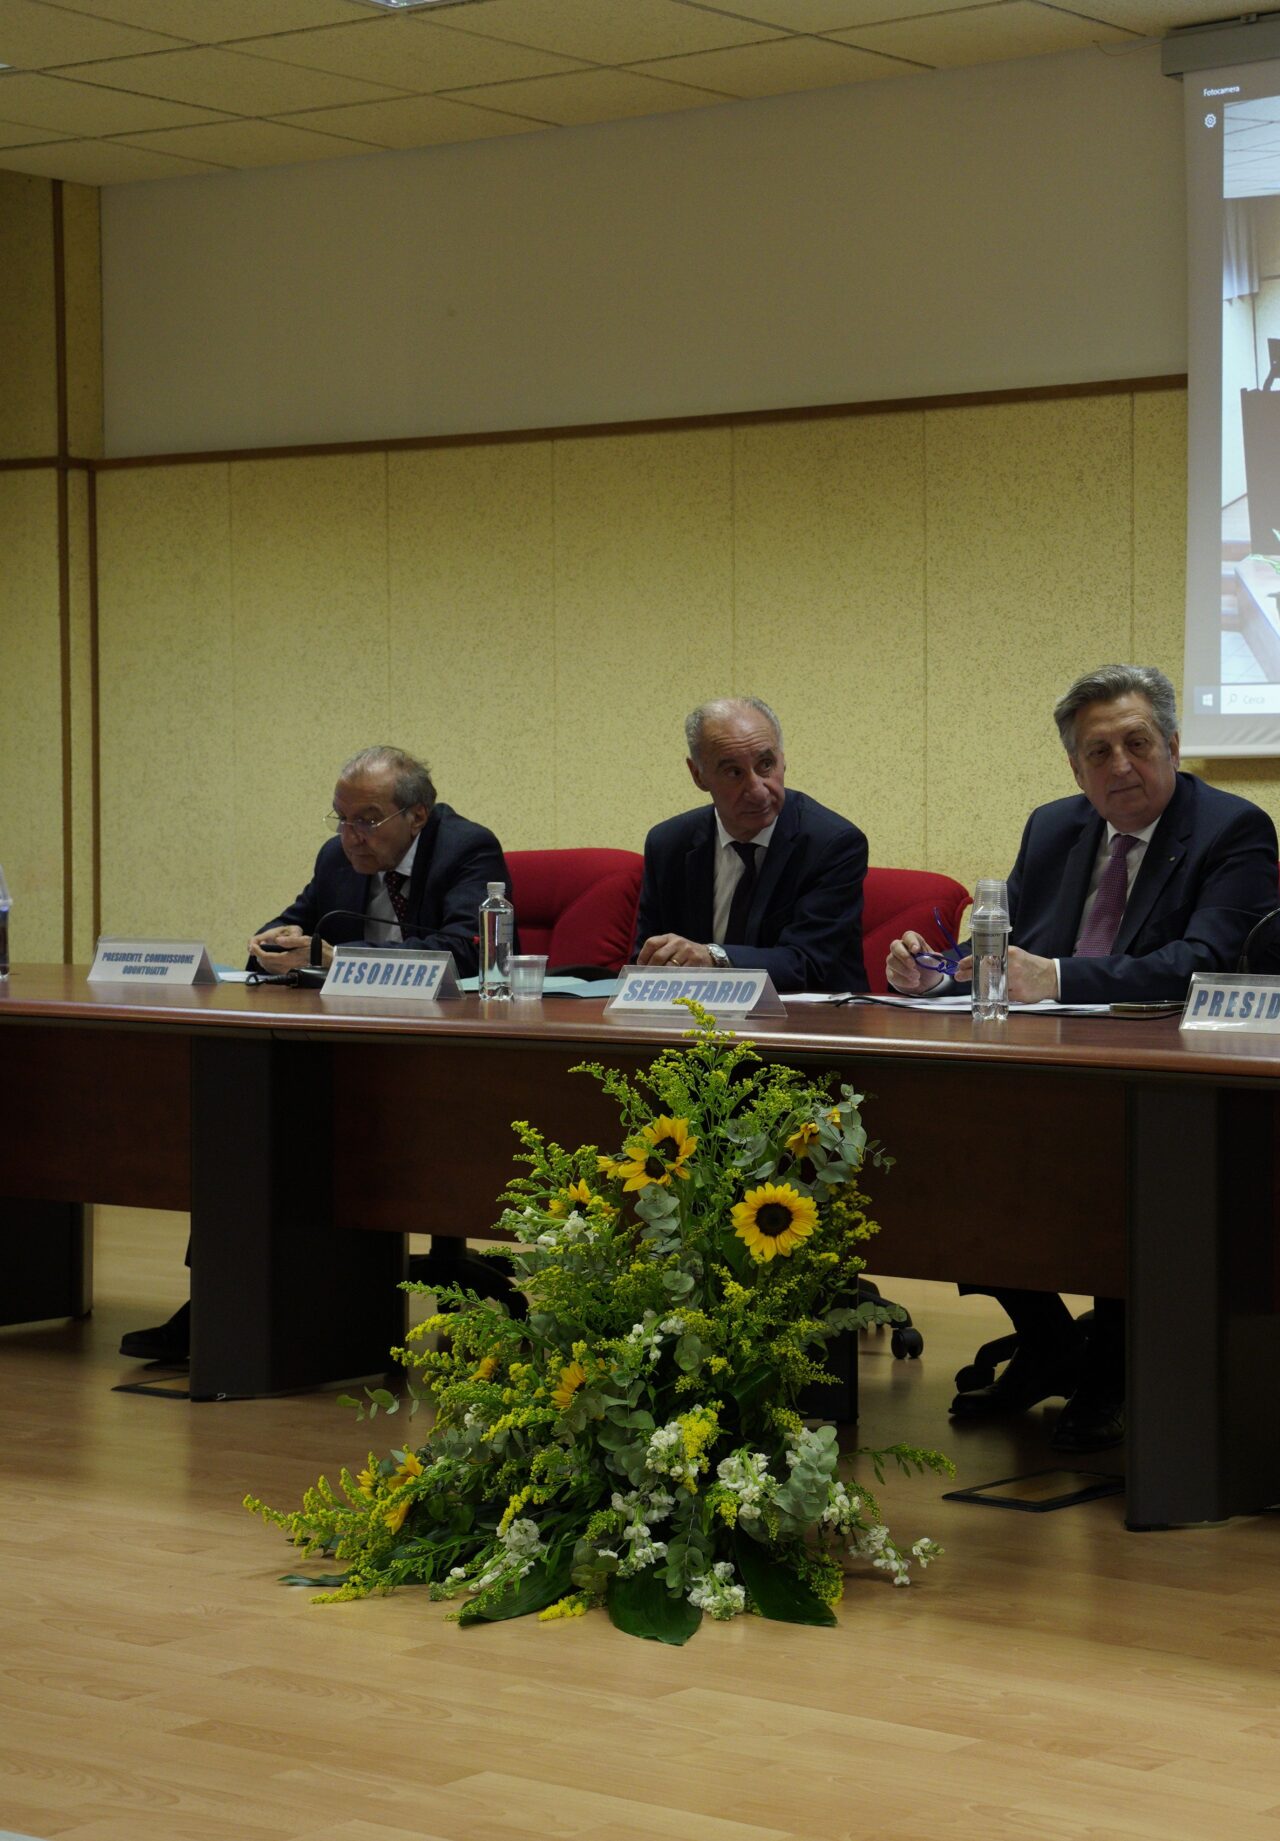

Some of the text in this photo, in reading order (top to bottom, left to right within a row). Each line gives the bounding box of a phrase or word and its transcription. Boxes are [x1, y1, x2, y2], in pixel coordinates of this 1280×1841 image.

[1203, 86, 1240, 97] Fotocamera
[102, 952, 195, 964] PRESIDENTE COMMISSIONE
[122, 965, 169, 976] ODONTOIATRI
[332, 961, 440, 987] TESORIERE
[622, 979, 758, 1004] SEGRETARIO
